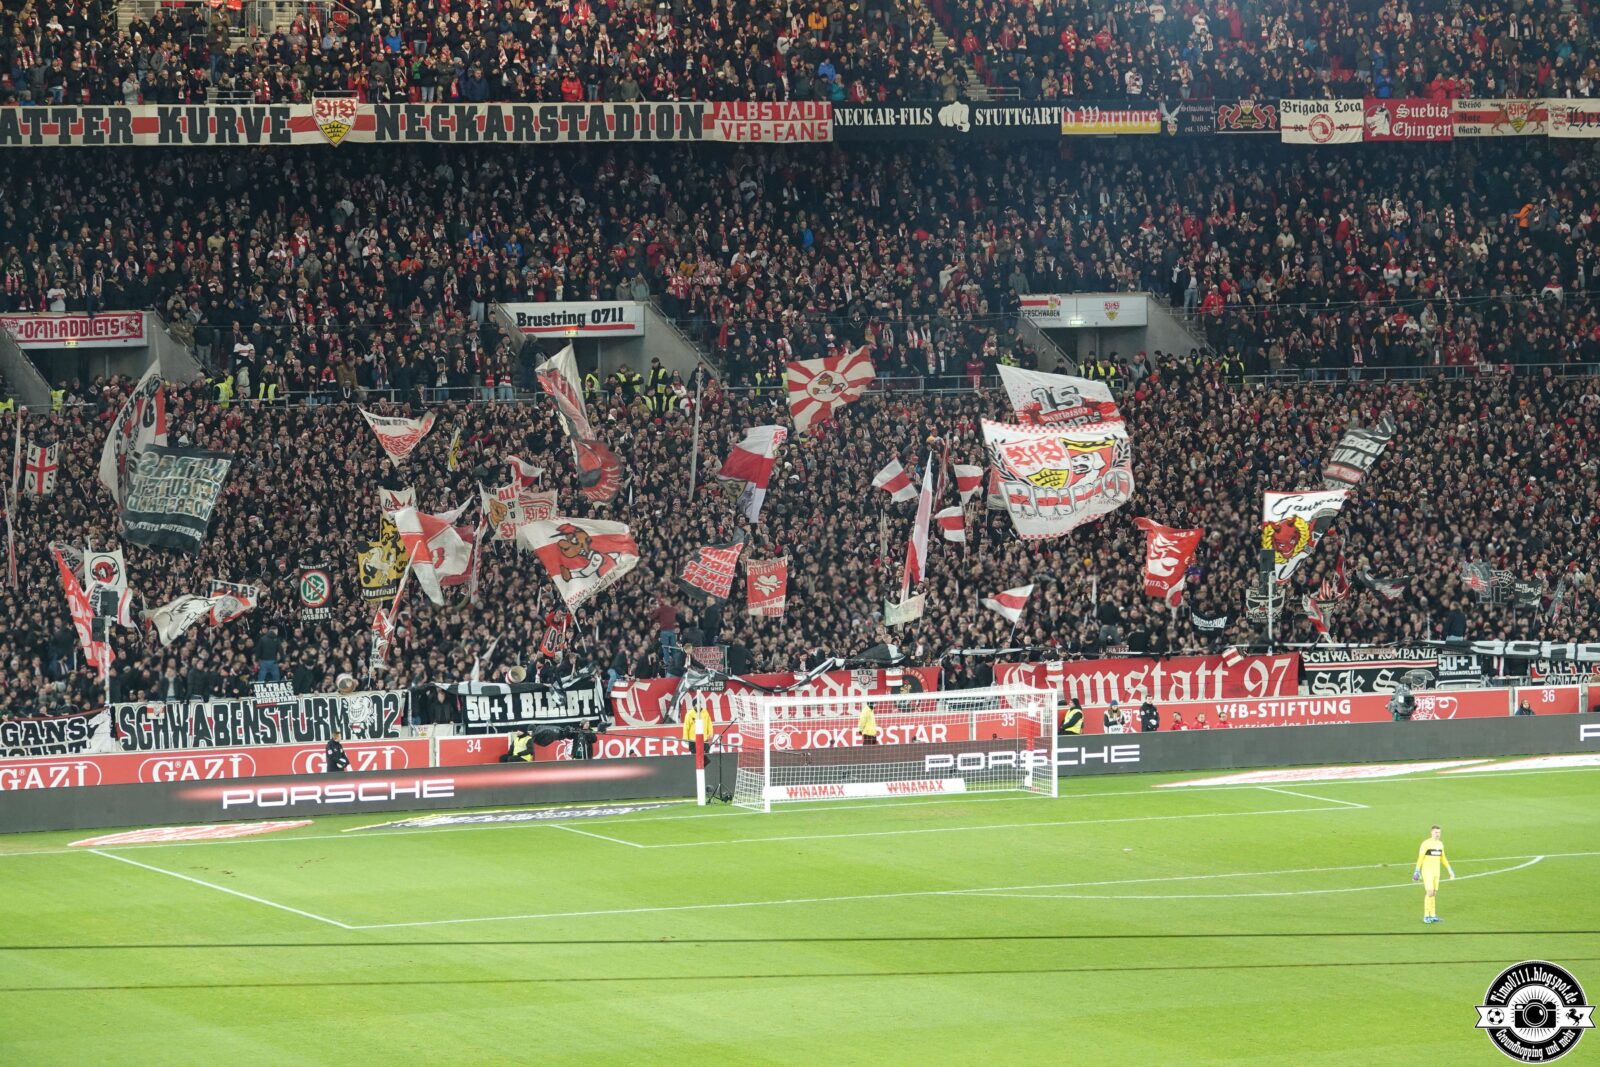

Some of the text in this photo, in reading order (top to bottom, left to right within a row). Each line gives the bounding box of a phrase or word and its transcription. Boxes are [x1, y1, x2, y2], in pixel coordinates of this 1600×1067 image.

[718, 101, 832, 120] ALBSTADT
[1281, 101, 1361, 116] Brigada Loca
[1396, 103, 1448, 119] Suebia
[1458, 101, 1482, 109] Weiss
[0, 105, 291, 145] ATTER KURVE
[375, 103, 704, 142] NECKARSTADION
[834, 105, 1061, 126] NECKAR-FILS STUTTGART
[1079, 104, 1159, 129] Warriors
[720, 121, 829, 141] VFB-FANS
[1458, 126, 1482, 134] Garde
[516, 307, 624, 328] Brustring 0711
[25, 319, 120, 339] 0711 ADDICTS
[1438, 655, 1481, 670] 50+1
[254, 682, 293, 692] ULTRAS
[1243, 658, 1291, 698] 97
[1541, 689, 1555, 702] 36
[466, 694, 515, 721] 50+1
[1216, 700, 1351, 719] VfB-STIFTUNG
[119, 693, 400, 751] SCHWABENSTURM 02
[1001, 712, 1016, 727] 35
[0, 716, 87, 747] GANS
[467, 740, 481, 753] 34
[593, 733, 744, 759] JOKERSAR
[925, 744, 1140, 772] PORSCHE
[222, 778, 455, 809] PORSCHE
[787, 785, 845, 798] WINAMAX
[887, 780, 945, 794] WINAMAX
